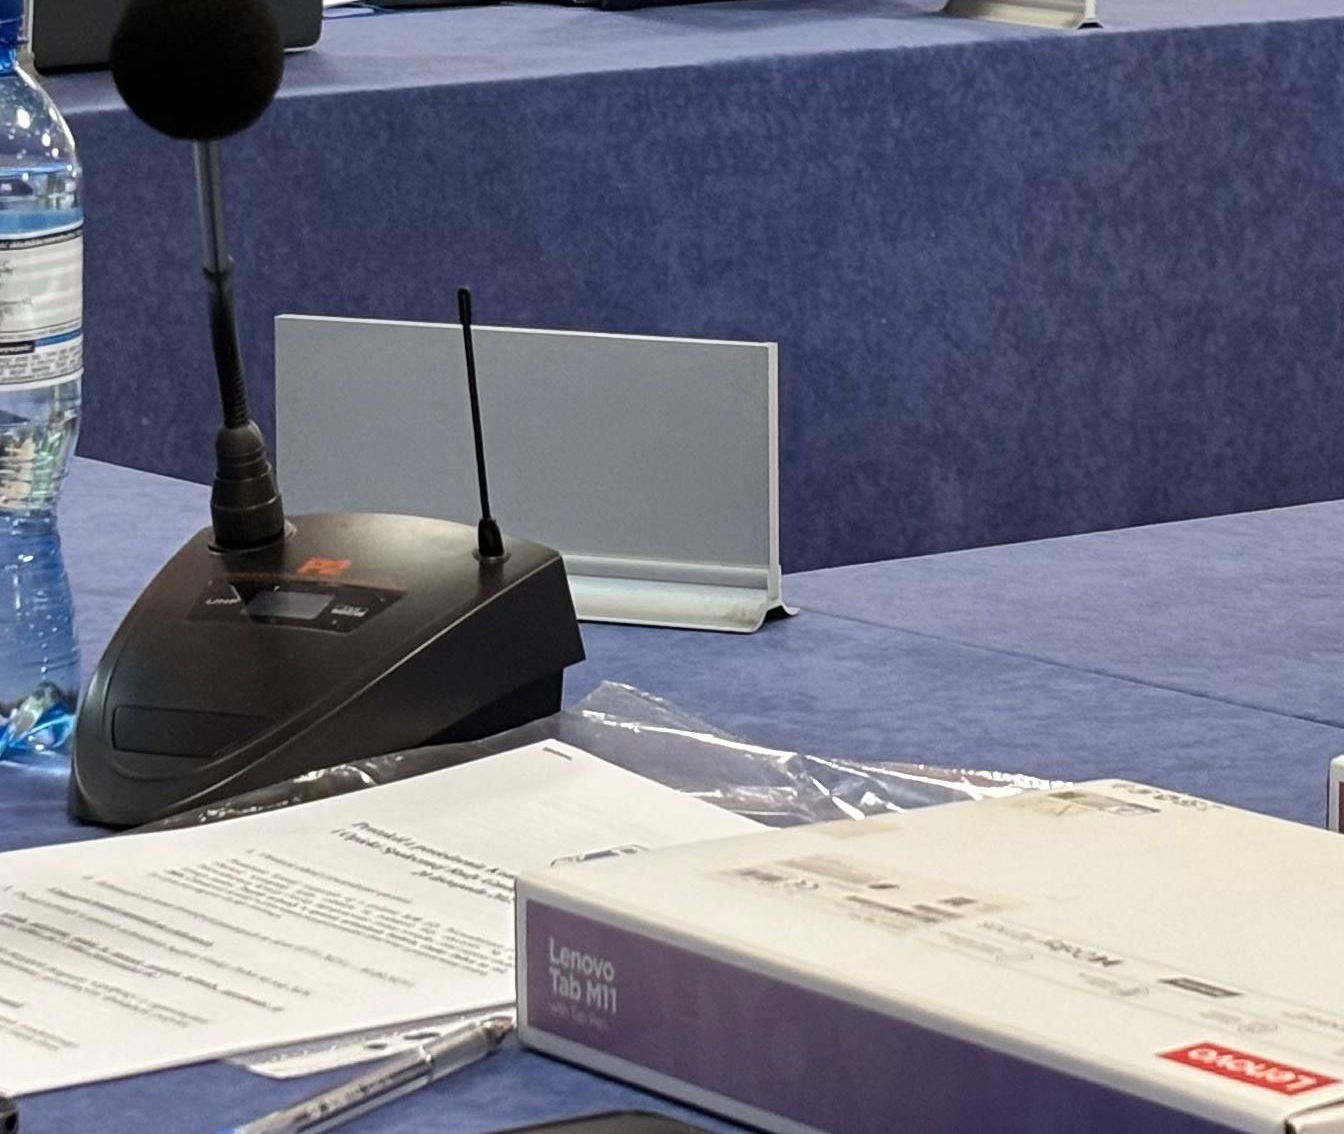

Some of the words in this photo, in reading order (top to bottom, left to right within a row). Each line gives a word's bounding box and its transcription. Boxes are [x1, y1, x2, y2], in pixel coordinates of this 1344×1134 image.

[549, 935, 615, 982] Lenovo
[549, 966, 582, 1002] Tab
[586, 978, 617, 1014] M11
[1186, 1047, 1318, 1091] Lenovo
